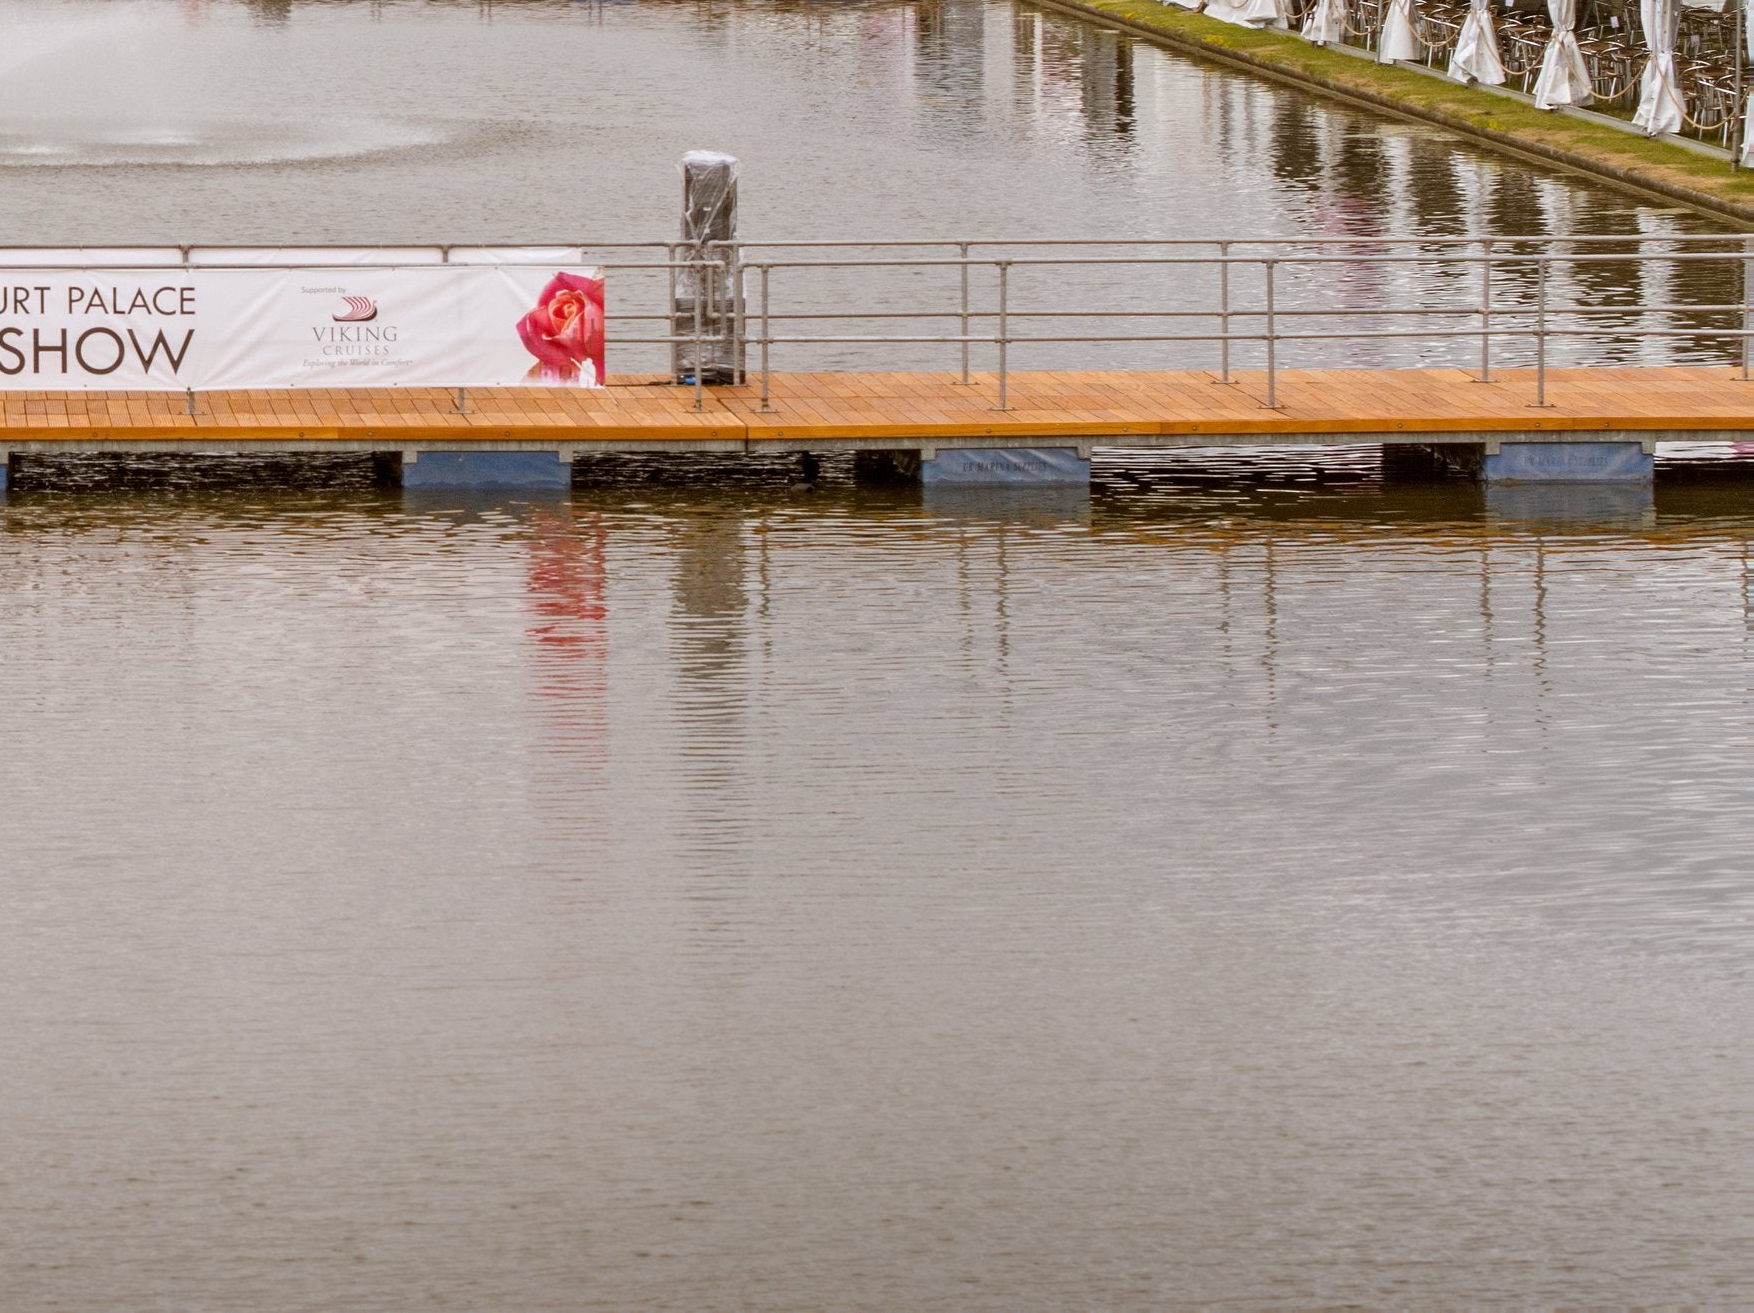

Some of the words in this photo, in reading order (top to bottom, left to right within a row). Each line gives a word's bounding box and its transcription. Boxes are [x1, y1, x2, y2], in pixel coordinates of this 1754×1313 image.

[301, 286, 336, 294] Supported
[337, 286, 346, 294] by
[68, 286, 196, 315] PALACE
[312, 326, 398, 342] VIKING
[322, 345, 390, 356] CRUISES
[303, 359, 336, 368] Exploring
